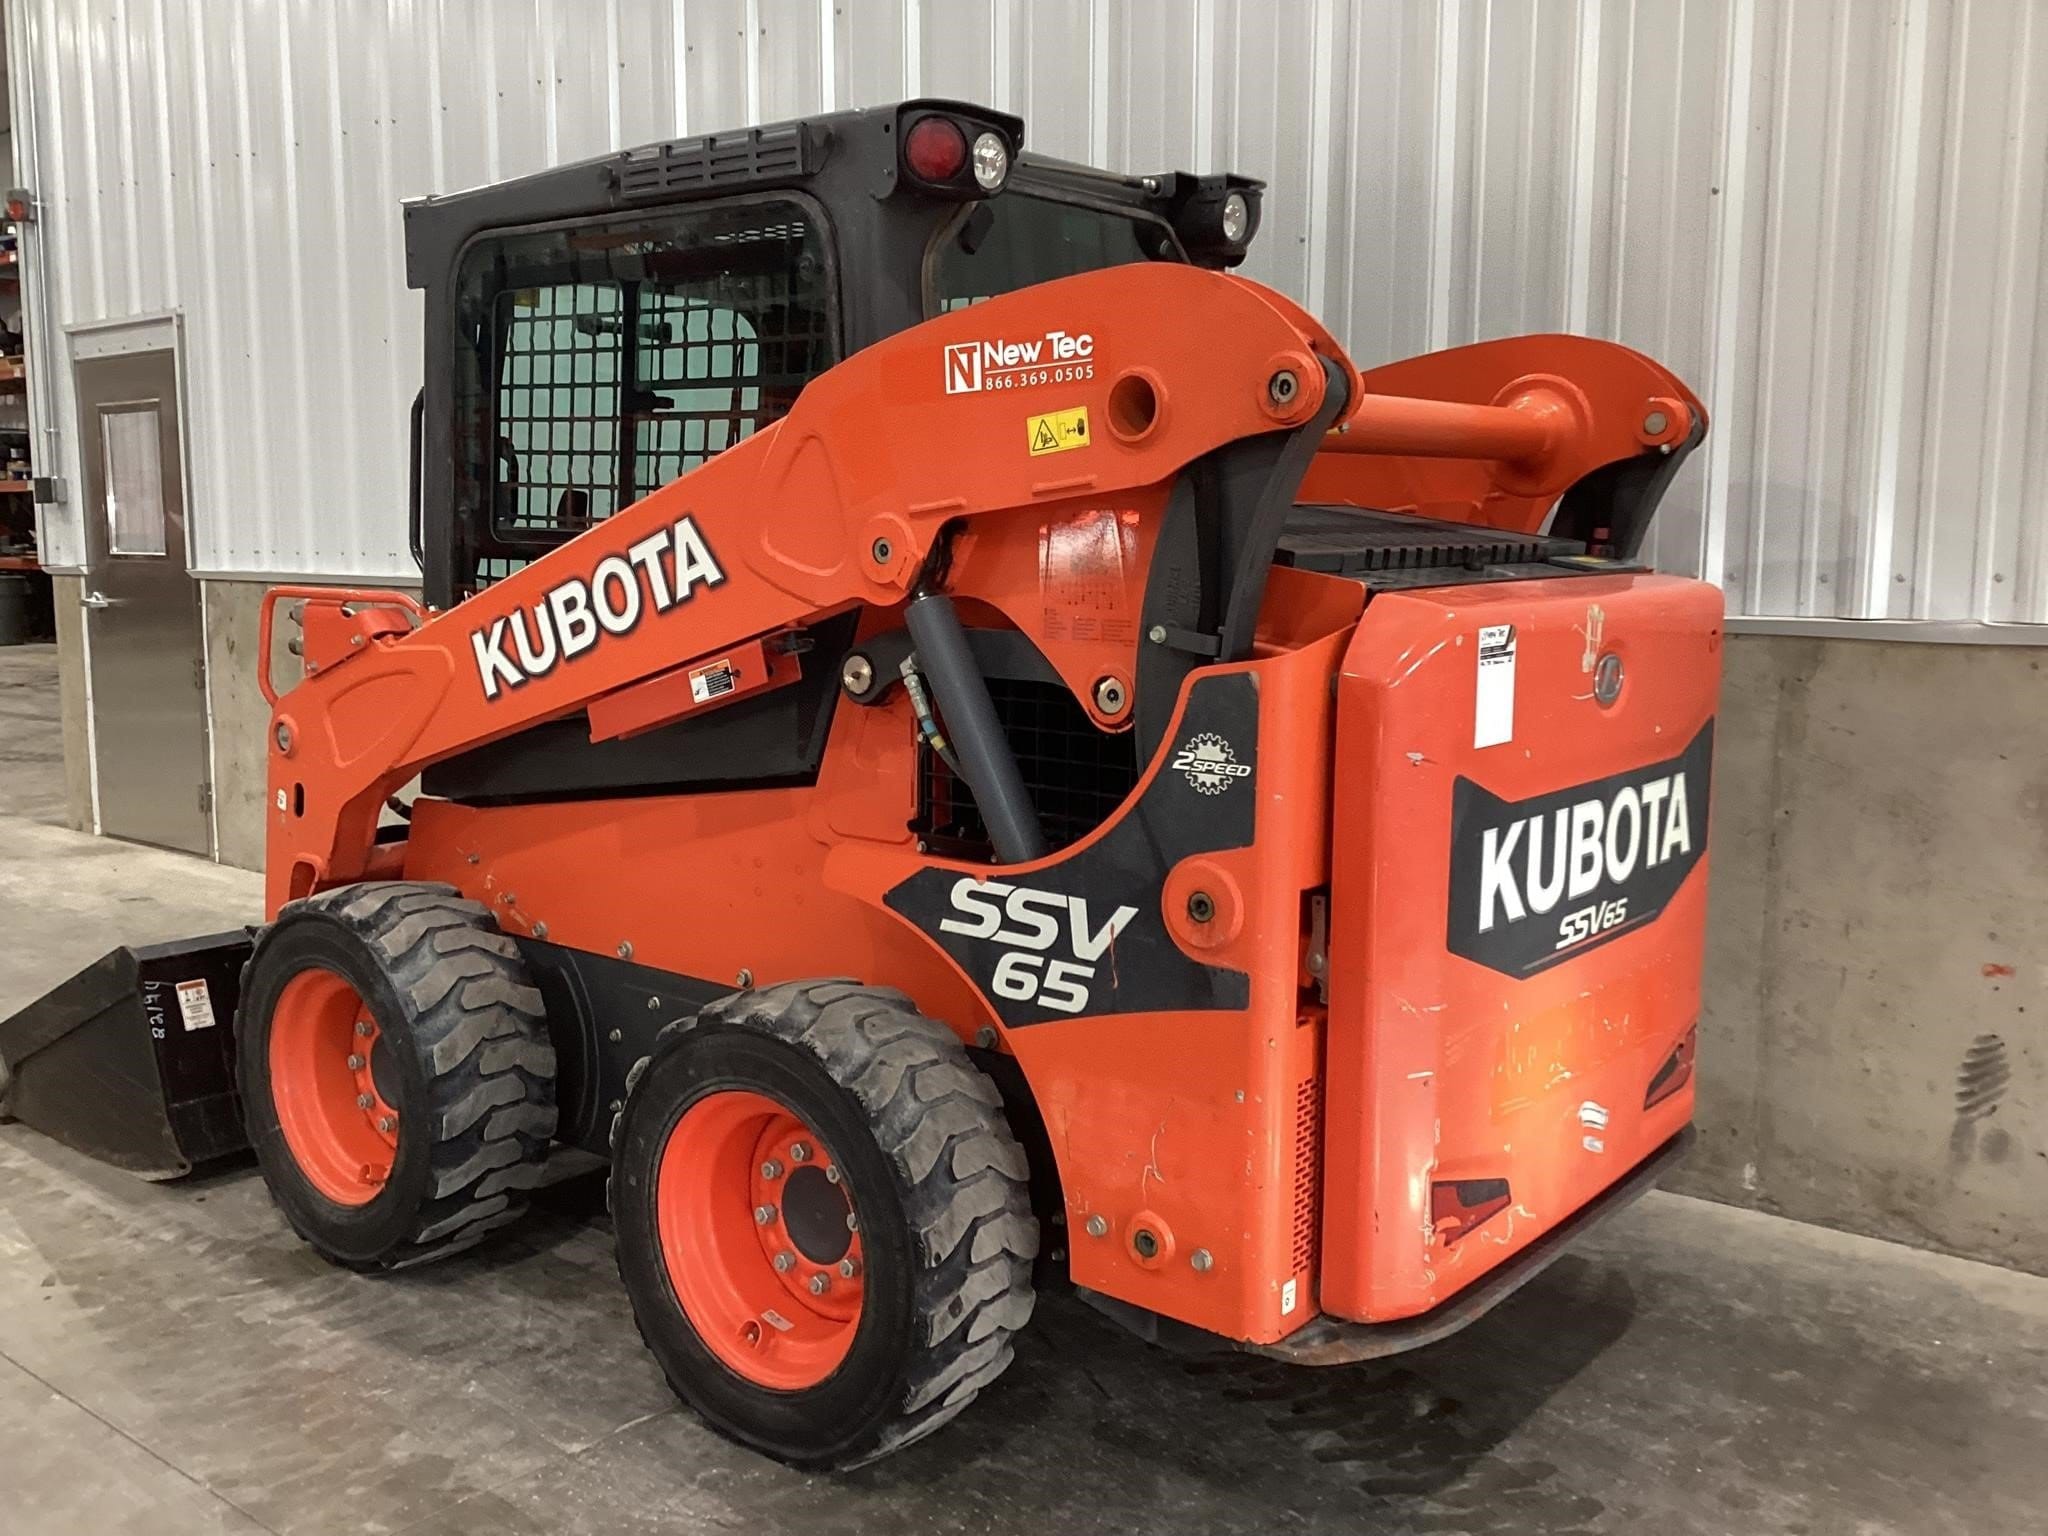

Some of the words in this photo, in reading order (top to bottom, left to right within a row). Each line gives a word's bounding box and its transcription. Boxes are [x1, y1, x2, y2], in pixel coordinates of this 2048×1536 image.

[984, 339, 1042, 369] New
[1045, 331, 1094, 360] Tec
[985, 365, 1094, 391] 866.369.0505
[471, 516, 724, 699] KUBOTA
[1479, 772, 1690, 934] KUBOTA
[939, 877, 1139, 962] SSV
[992, 952, 1095, 1013] 65
